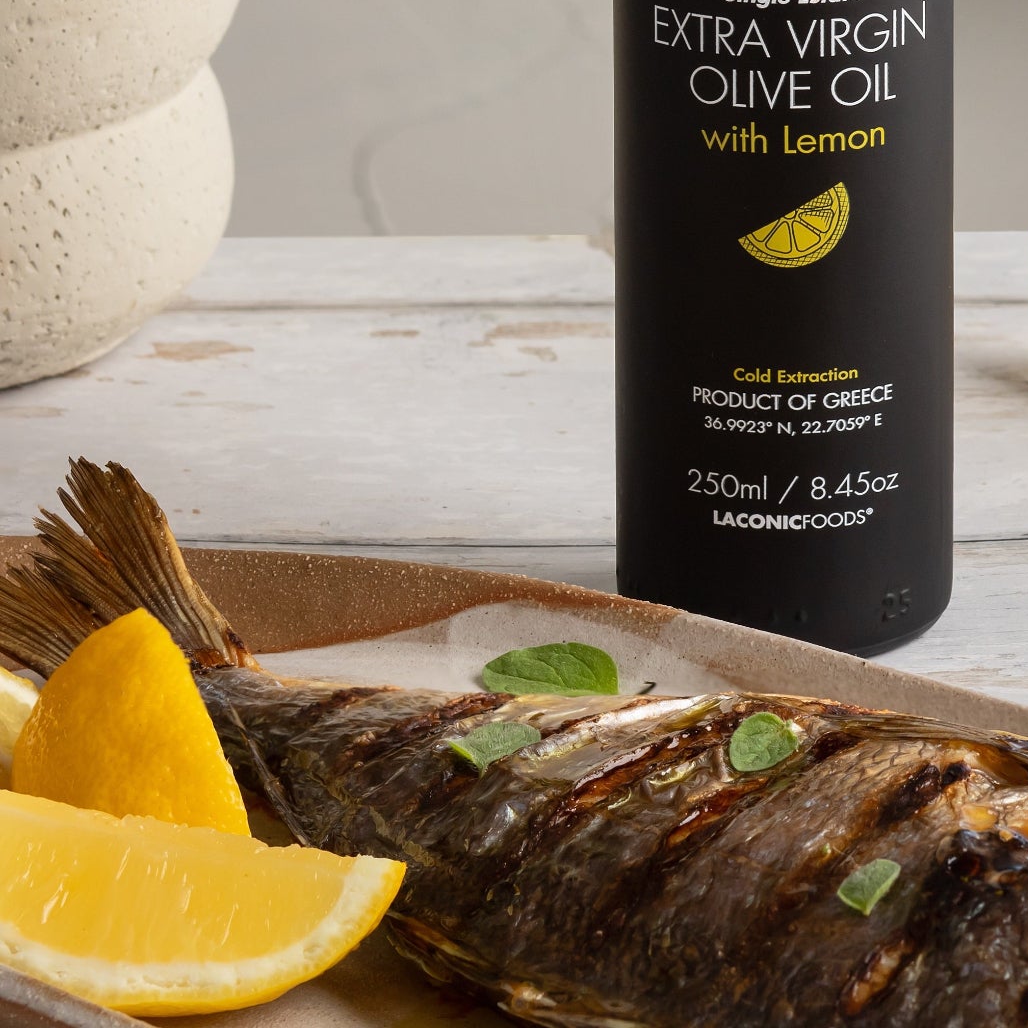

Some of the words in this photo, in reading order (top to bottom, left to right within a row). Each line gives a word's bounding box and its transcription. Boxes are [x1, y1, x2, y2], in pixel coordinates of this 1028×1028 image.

[654, 4, 771, 58] EXTRA
[786, 0, 926, 59] VIRGIN
[689, 65, 812, 110] OLIVE
[830, 61, 897, 107] OIL
[701, 121, 767, 154] with
[784, 125, 885, 154] Lemon
[733, 367, 771, 383] Cold
[777, 367, 859, 384] Extraction
[693, 386, 782, 411] PRODUCT
[787, 393, 817, 411] OF
[822, 383, 893, 409] GREECE
[704, 415, 773, 434] 36.9923°
[777, 421, 796, 437] N,
[801, 414, 871, 435] 22.7059°
[874, 412, 883, 427] E
[688, 468, 767, 500] 250ml
[778, 475, 799, 505] /
[810, 470, 899, 500] 8.45oz
